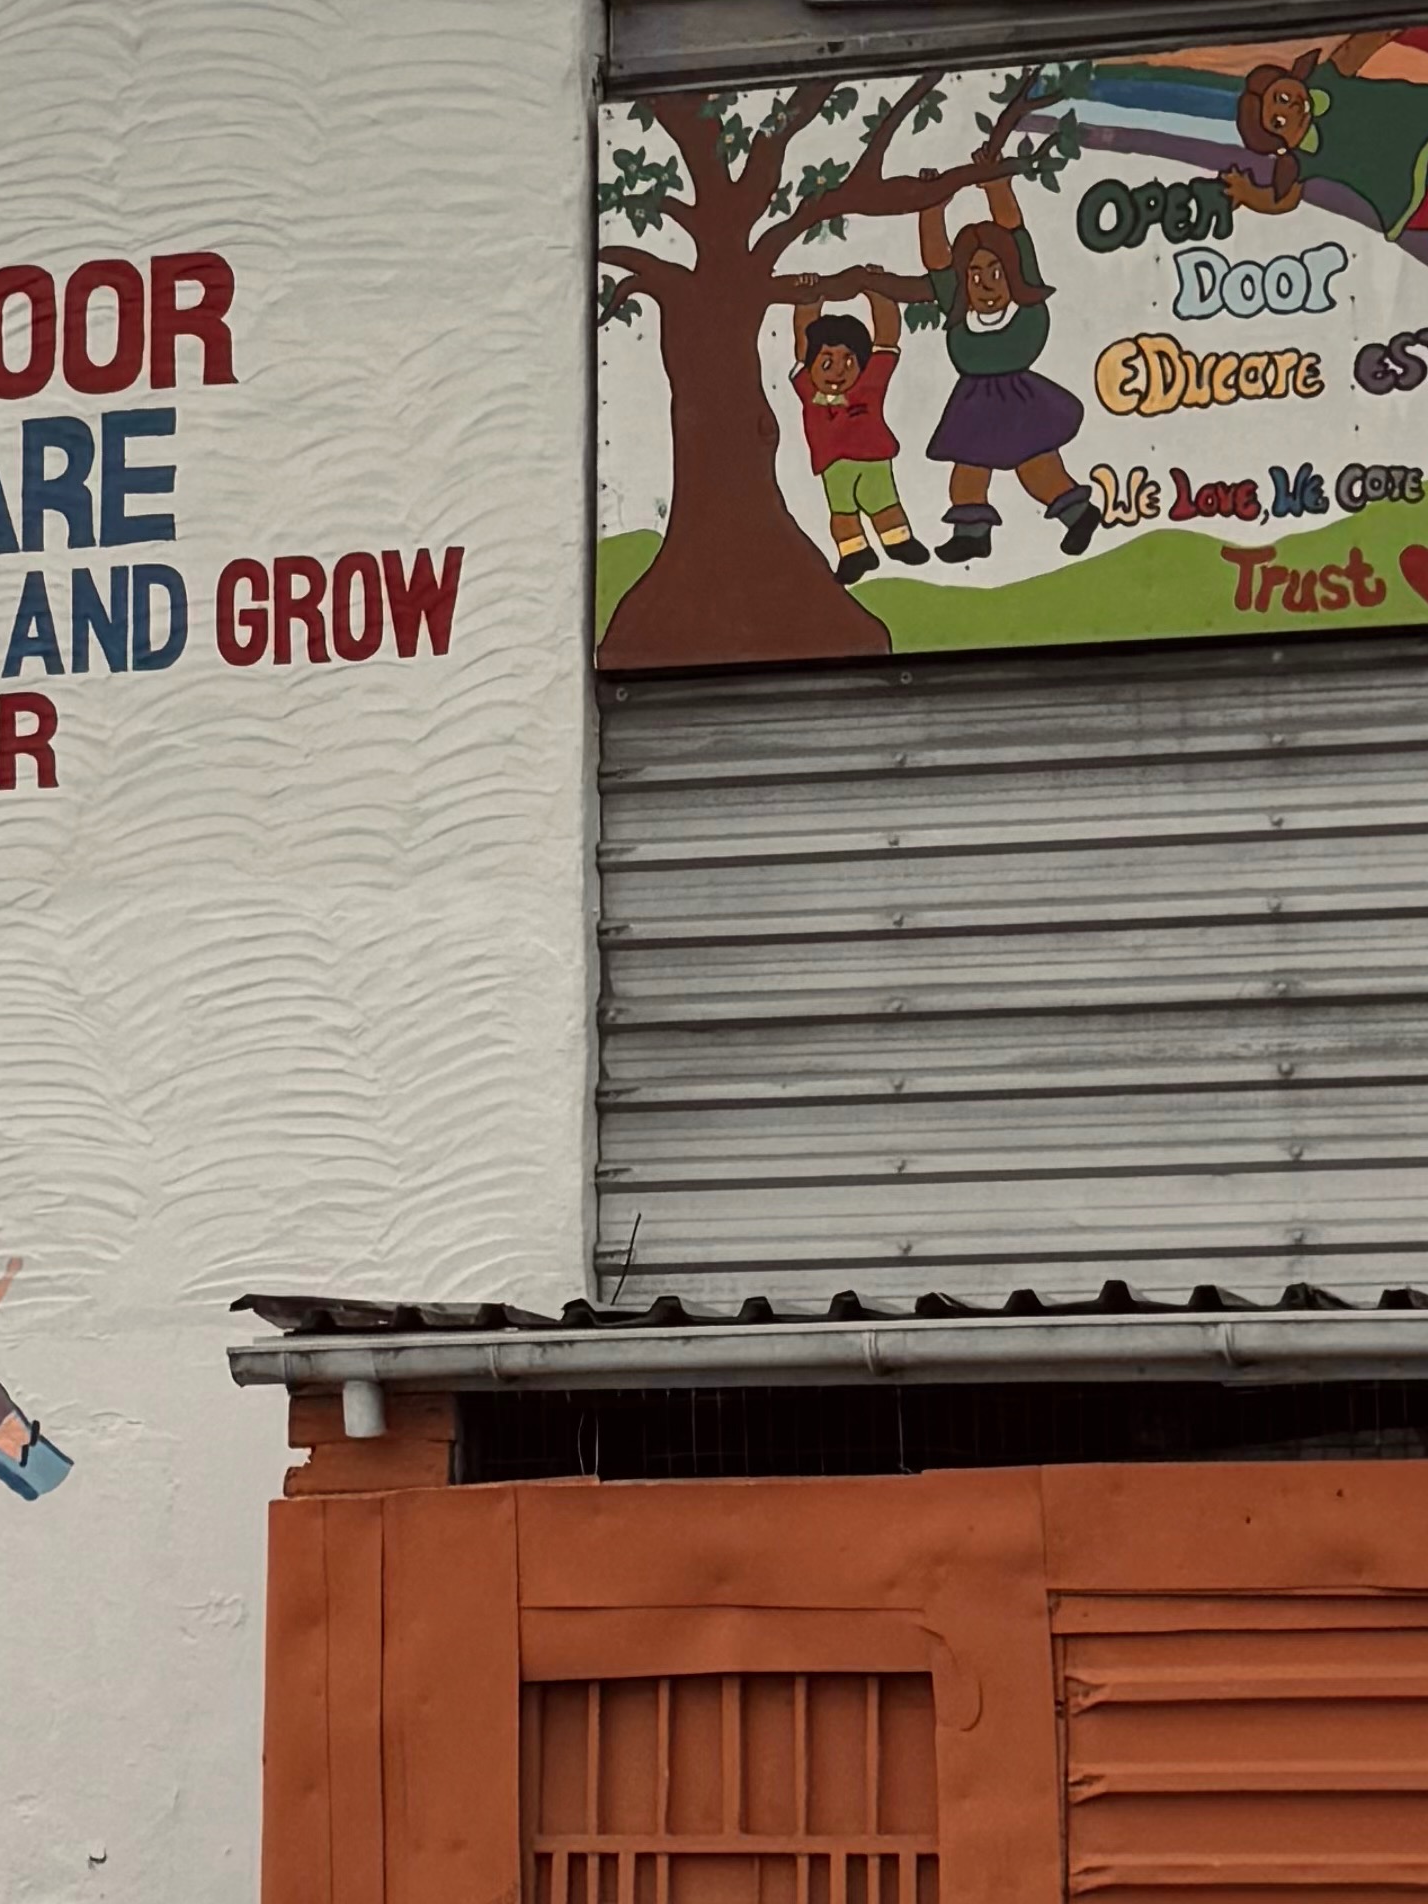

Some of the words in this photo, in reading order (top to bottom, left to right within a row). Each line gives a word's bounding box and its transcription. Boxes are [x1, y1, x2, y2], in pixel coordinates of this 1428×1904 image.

[1172, 241, 1348, 321] Door
[0, 563, 189, 679] AND
[214, 545, 466, 667] GROW
[1220, 546, 1387, 614] Trust
